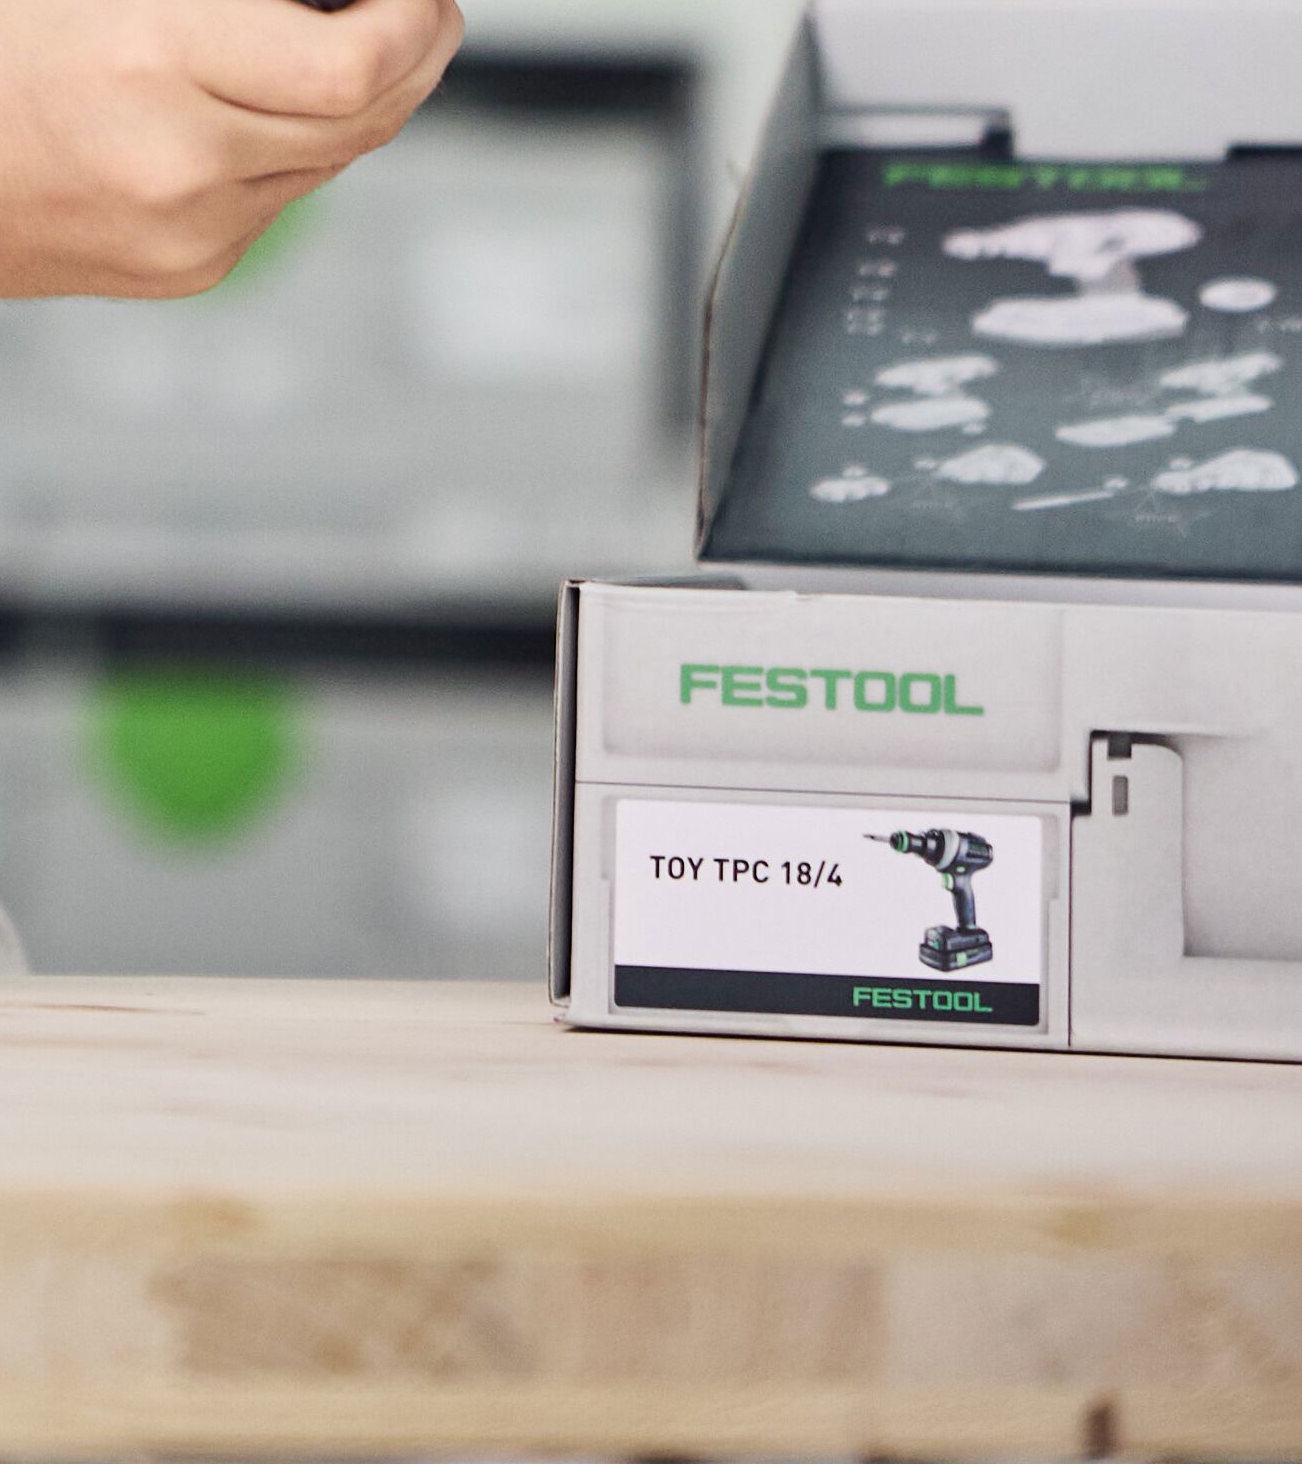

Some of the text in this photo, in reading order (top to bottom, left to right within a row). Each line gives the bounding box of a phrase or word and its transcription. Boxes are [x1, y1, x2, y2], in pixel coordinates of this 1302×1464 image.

[679, 663, 985, 716] FESTOOL
[649, 855, 843, 888] TOY TPC 18/4
[852, 986, 994, 1013] FESTOOL
